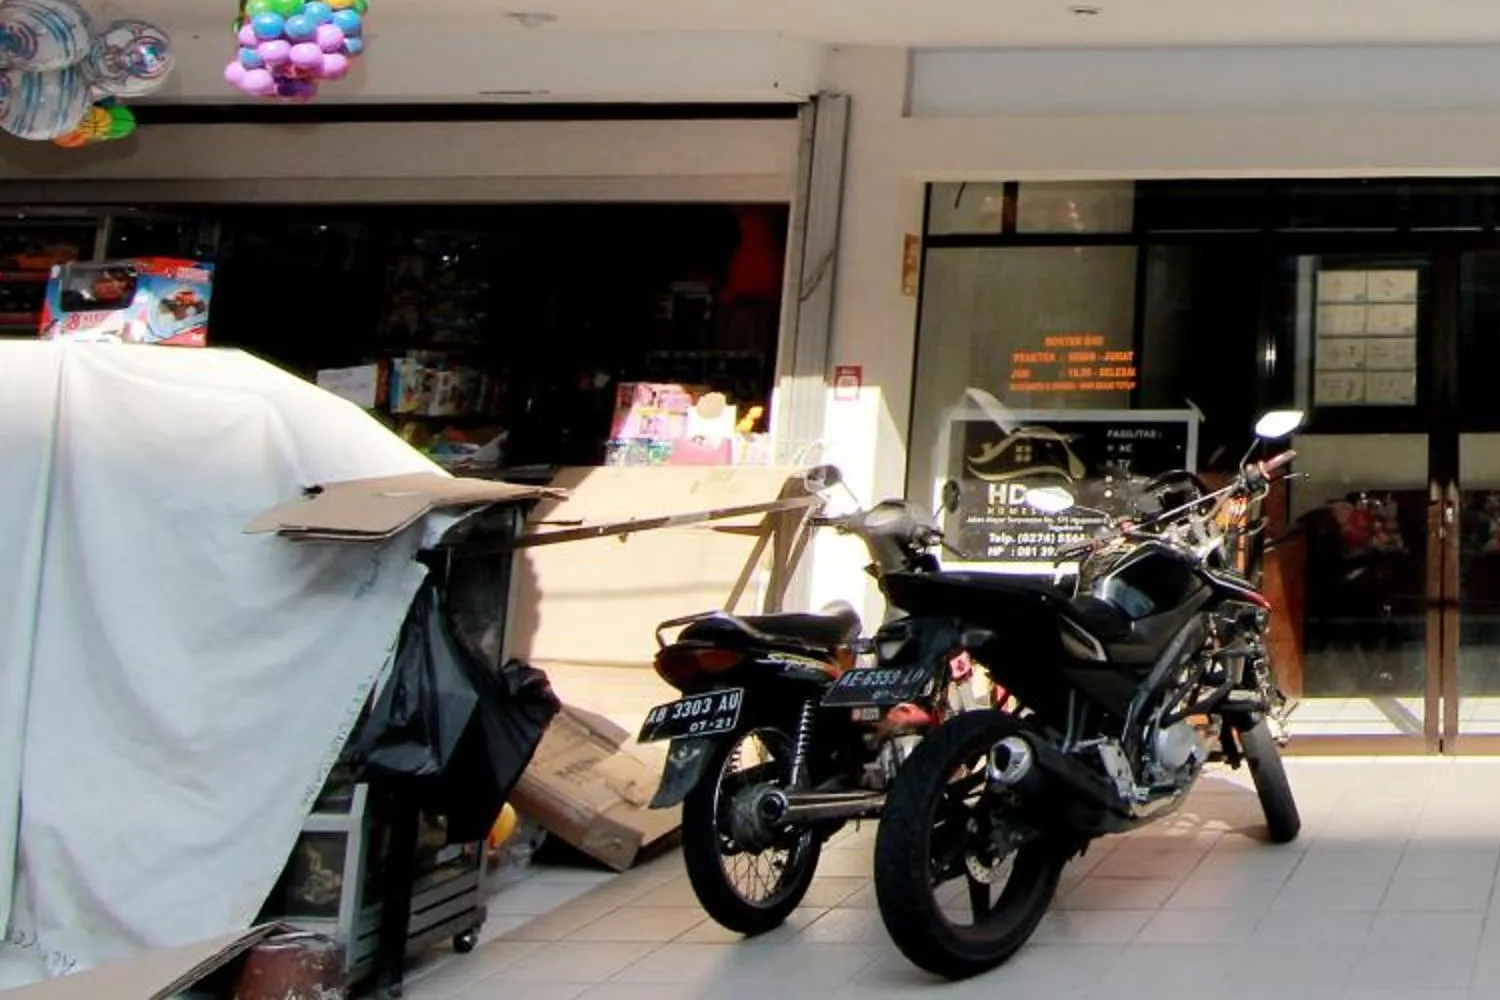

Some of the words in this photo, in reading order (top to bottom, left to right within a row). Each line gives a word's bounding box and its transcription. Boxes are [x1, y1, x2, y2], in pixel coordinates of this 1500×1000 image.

[987, 482, 1027, 505] HD
[988, 532, 1016, 545] Telp.
[647, 707, 668, 724] AB
[672, 697, 713, 719] 3303
